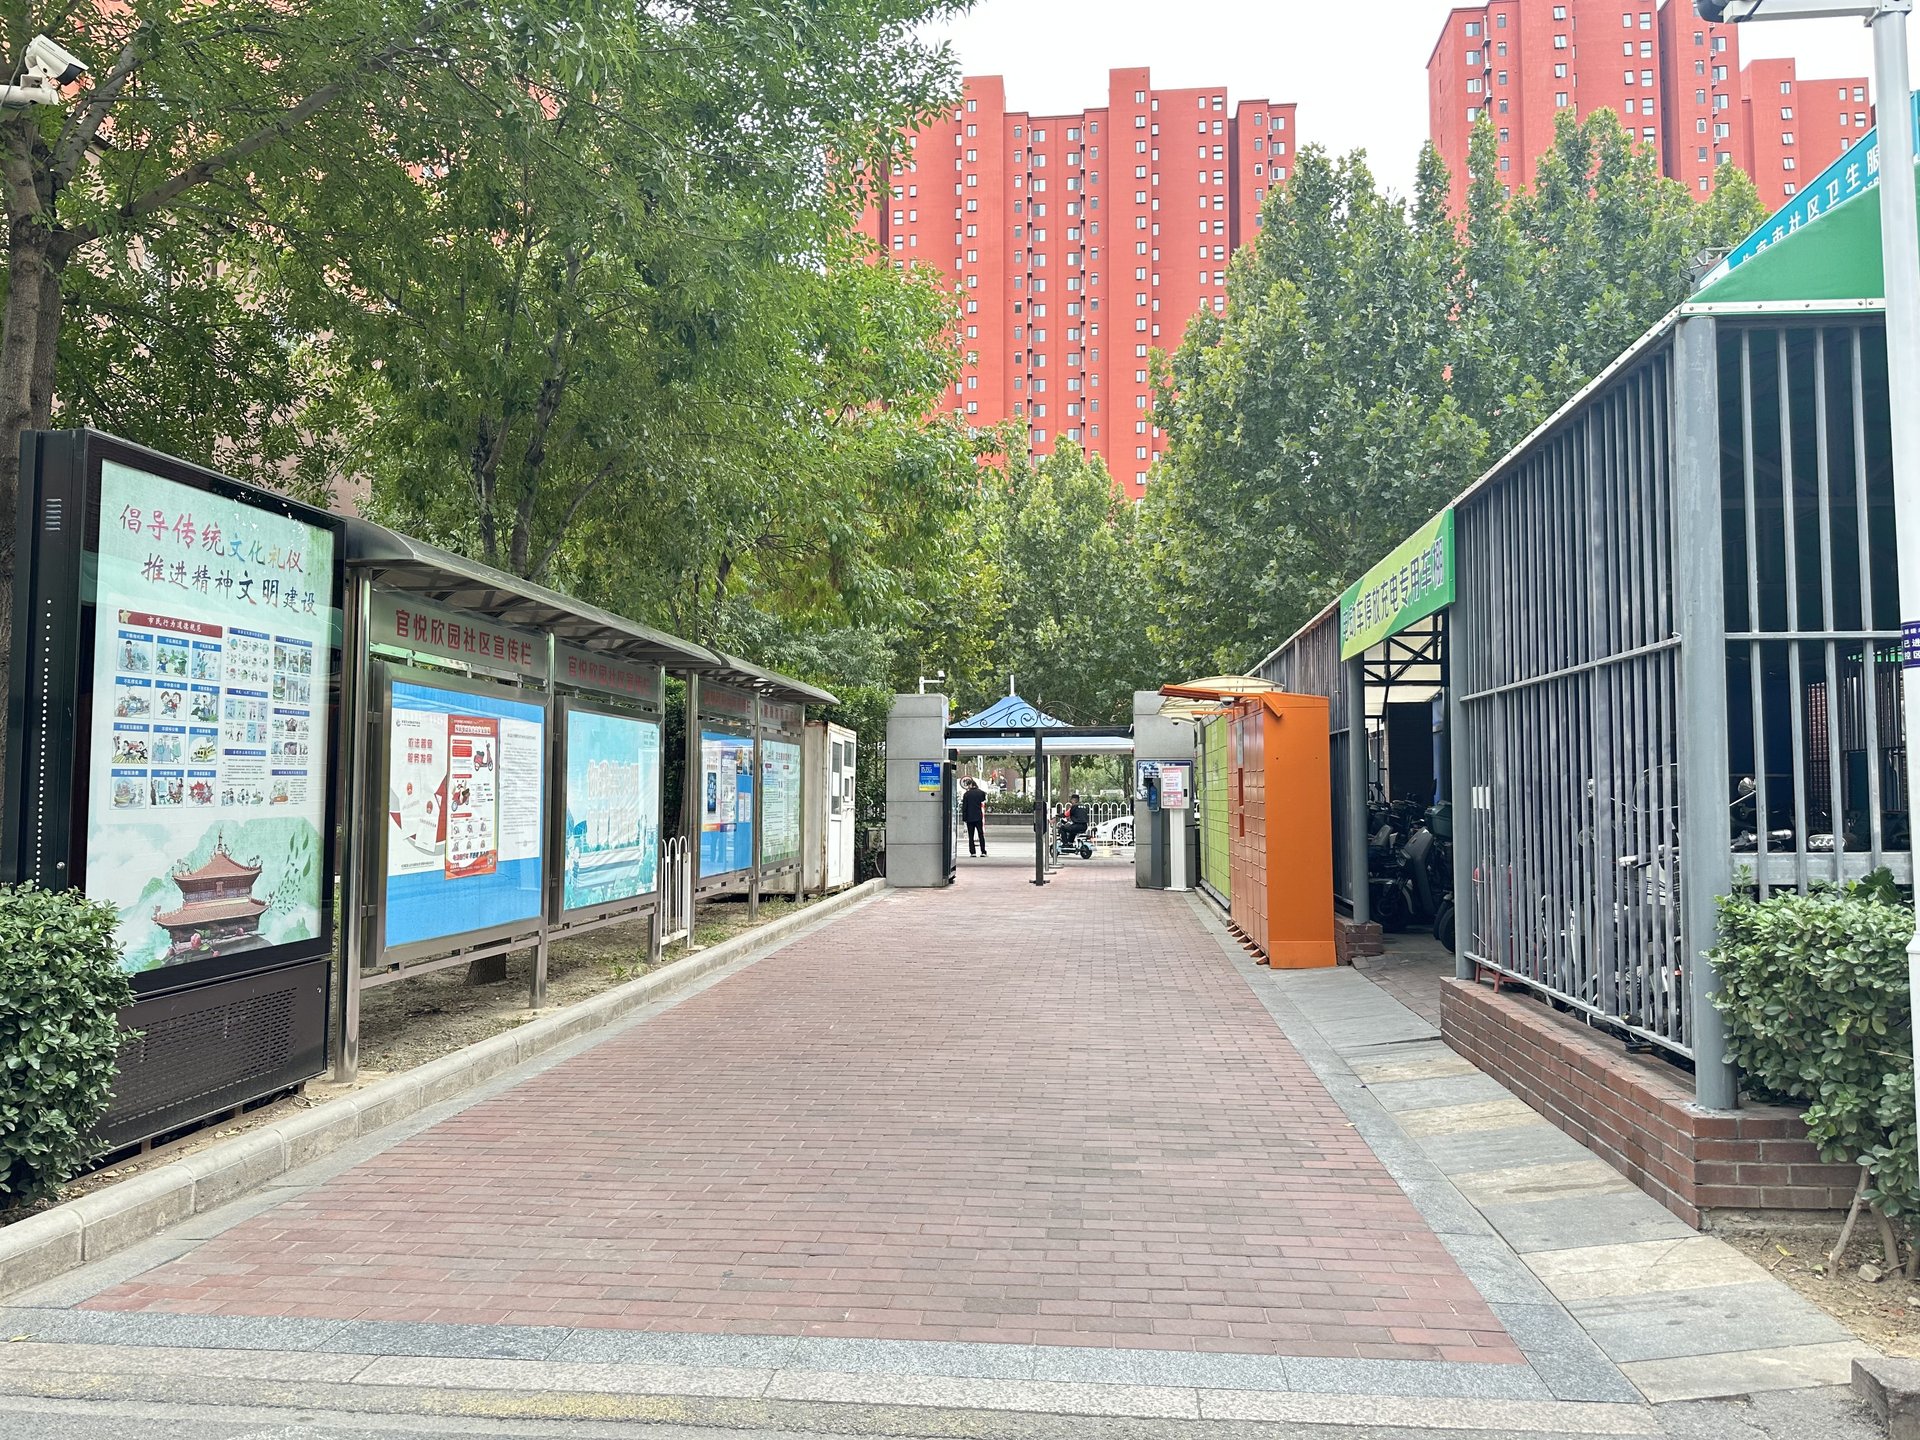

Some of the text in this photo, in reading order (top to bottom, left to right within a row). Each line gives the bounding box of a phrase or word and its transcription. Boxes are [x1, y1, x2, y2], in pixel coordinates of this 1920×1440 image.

[1742, 144, 1879, 262] 市社区卫生服
[120, 504, 303, 572] 倡导传统文化礼仪
[141, 552, 317, 615] 推进精神文明建设
[1342, 536, 1444, 642] 电动车停放充电专用车棚
[395, 609, 532, 666] 官悦欣园社区宣传栏
